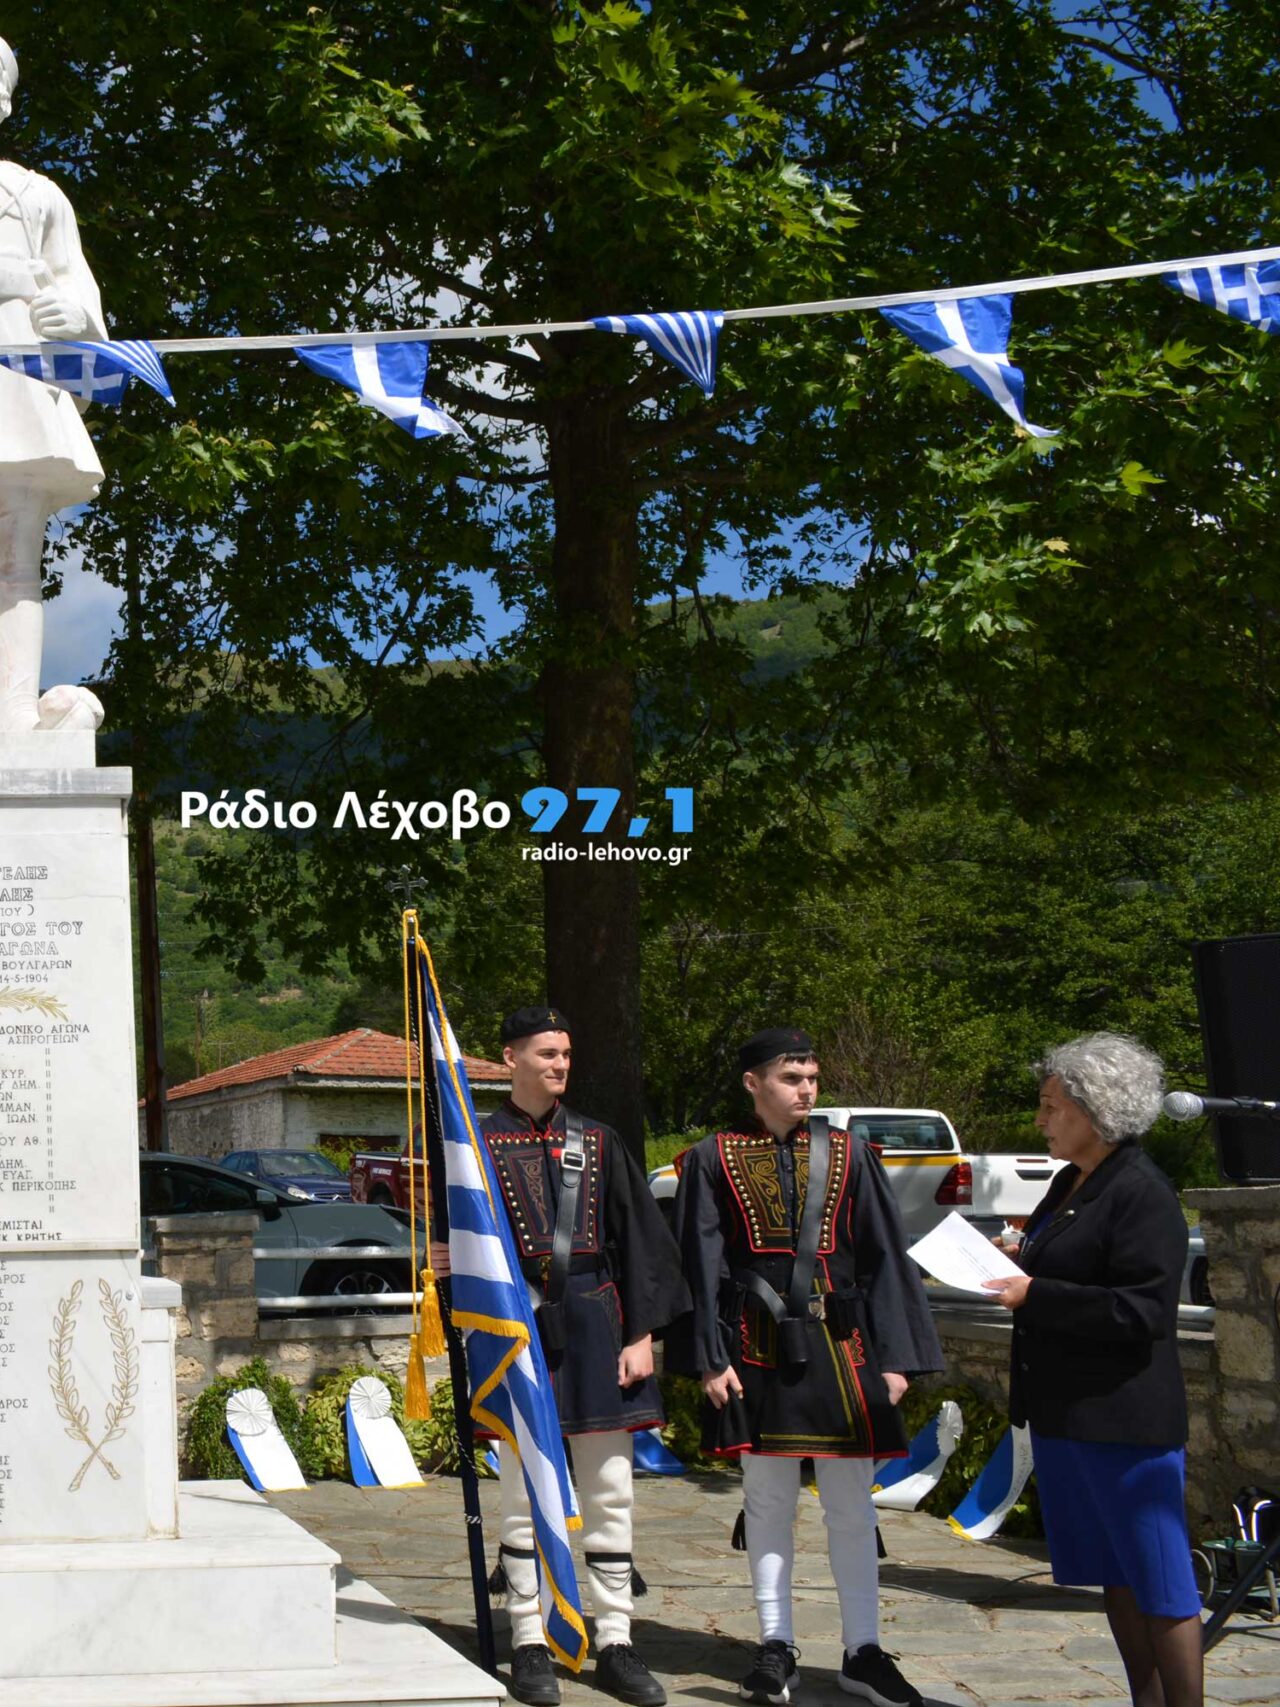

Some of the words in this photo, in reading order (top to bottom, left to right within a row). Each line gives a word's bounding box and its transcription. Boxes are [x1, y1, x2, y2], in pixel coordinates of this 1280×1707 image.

[45, 921, 83, 935] ΤΟΥ
[1, 960, 72, 970] ΒΟΥΛΓΑΡΩΝ
[0, 973, 48, 983] 14-5-1904
[51, 1024, 90, 1034] ΑΓΩΝΑ
[7, 1034, 79, 1045] ΑΣΠΡΟΓΕΙΩΝ
[12, 1180, 77, 1191] ΠΕΡΙΚΟΠΗΣ
